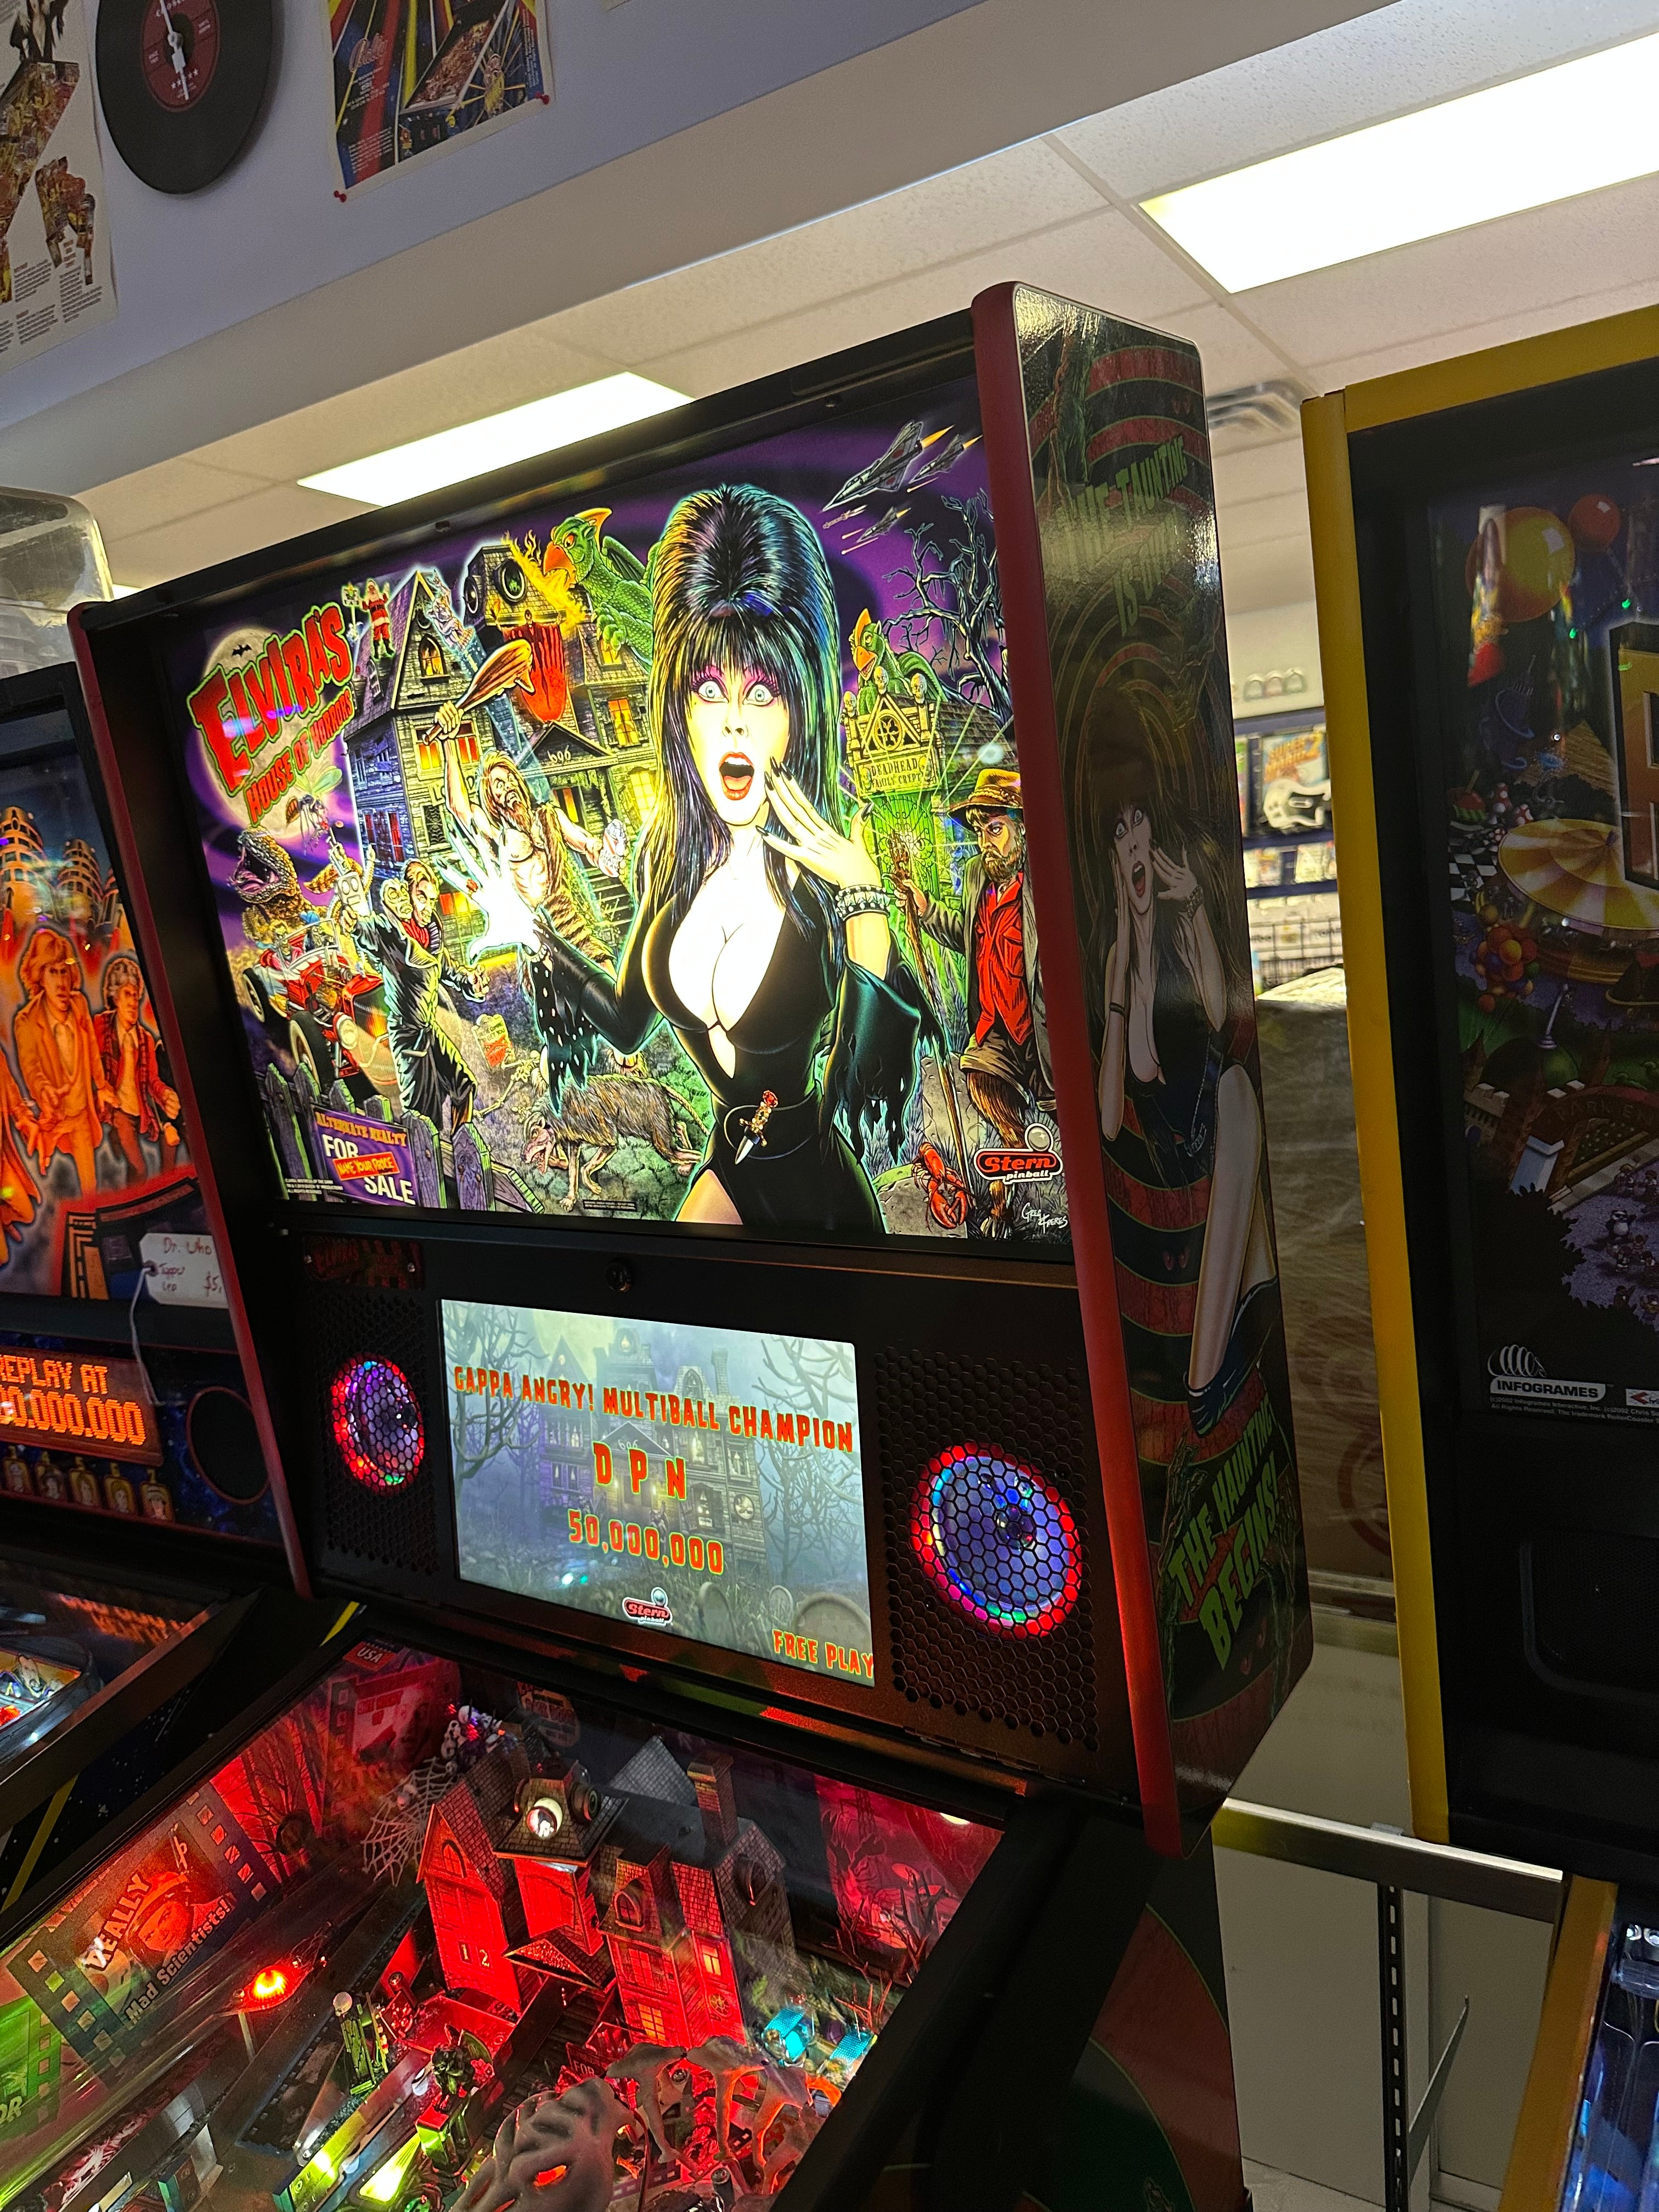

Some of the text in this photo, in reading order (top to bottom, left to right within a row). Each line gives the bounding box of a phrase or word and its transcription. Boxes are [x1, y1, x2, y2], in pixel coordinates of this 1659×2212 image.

[1115, 436, 1188, 527] TAUNTING
[189, 605, 352, 792] ELVIRA'S
[247, 690, 353, 823] HOUSE OF HORRORS
[871, 758, 917, 776] DEADHEAD
[871, 774, 921, 788] FAMILY CRYPT
[315, 1111, 407, 1147] ALTERNATE REALTY
[322, 1134, 359, 1159] FOR
[984, 1155, 1054, 1171] Stern
[336, 1160, 356, 1175] NAME
[355, 1159, 373, 1172] YOUR
[1006, 1170, 1050, 1181] pinball
[364, 1175, 416, 1205] SALE
[163, 1237, 180, 1254] Dr.
[80, 1363, 109, 1395] AT
[1497, 1380, 1599, 1398] INFOGRAMES
[454, 1365, 854, 1454] GAPPA ANGRY! MULTIBALL CHAMPION
[593, 1441, 687, 1501] D P N
[1168, 1393, 1273, 1607] THE HAUNTING
[568, 1509, 724, 1576] 50,000,000
[1199, 1450, 1280, 1671] BEGINS!
[628, 1603, 667, 1618] Stern
[357, 1646, 383, 1663] USA
[772, 1628, 874, 1679] FREE PLAY
[84, 1873, 150, 1970] REALLY
[125, 1899, 230, 2024] Mad Scientists!
